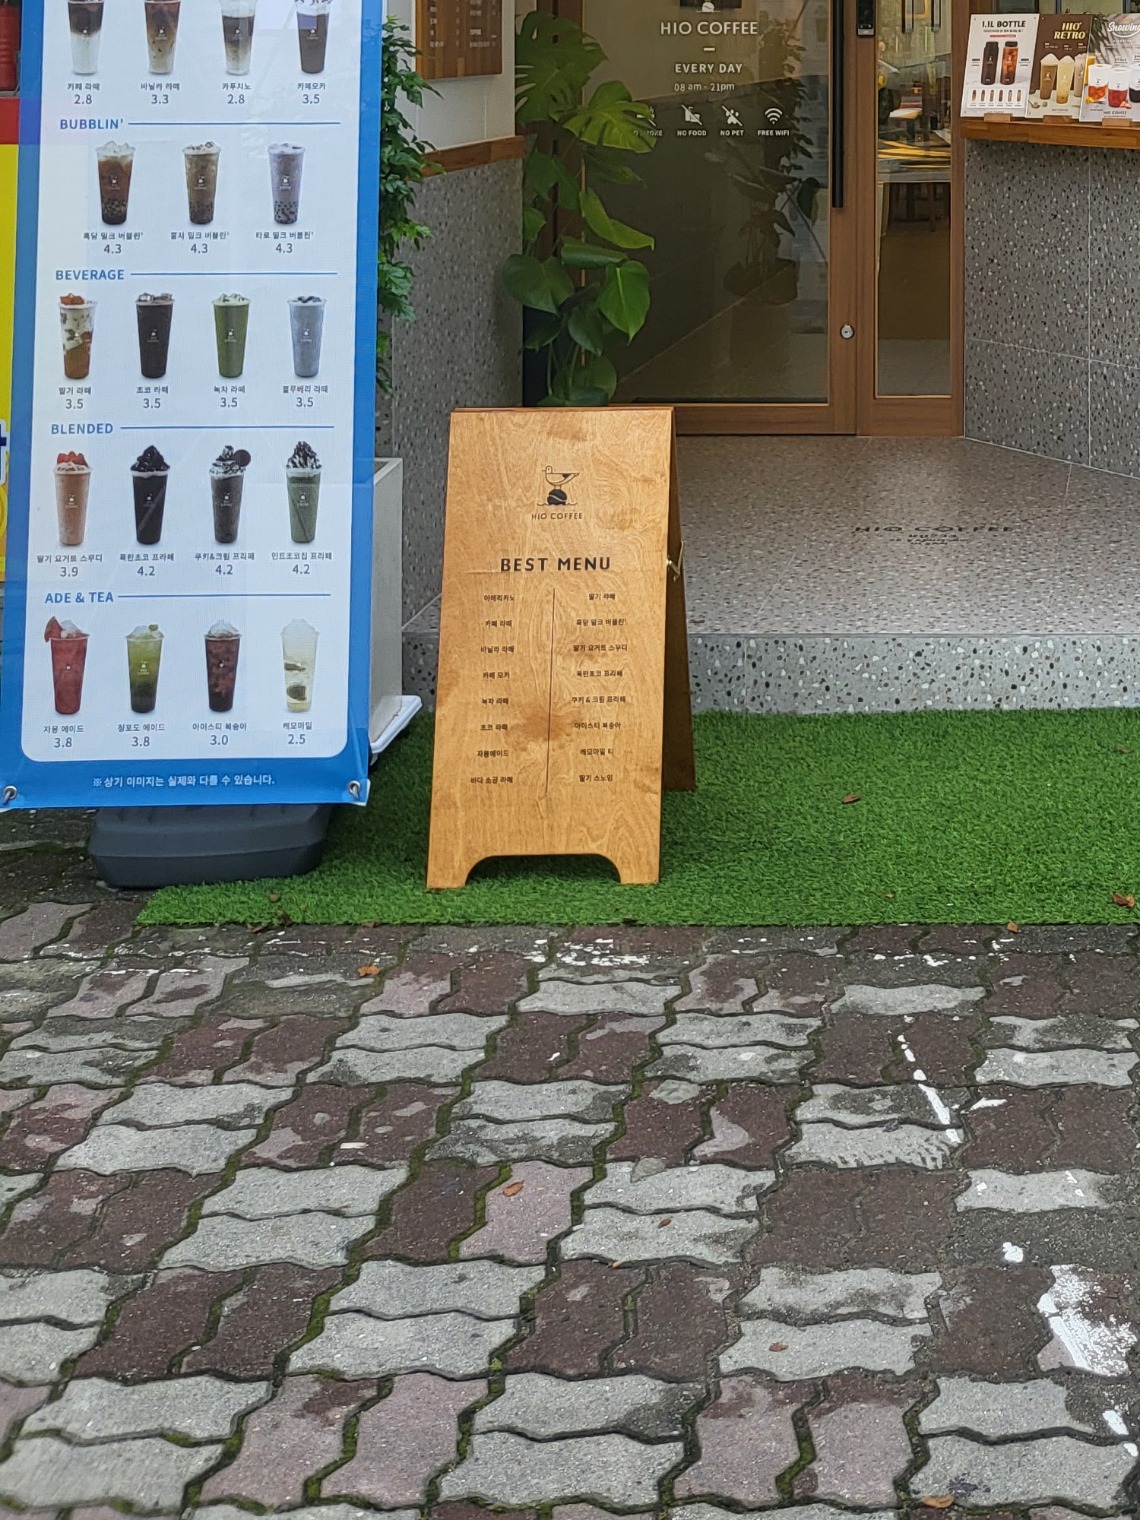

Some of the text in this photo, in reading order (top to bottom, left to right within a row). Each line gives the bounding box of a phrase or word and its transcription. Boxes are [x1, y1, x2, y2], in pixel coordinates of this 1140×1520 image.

[661, 21, 758, 35] HIO COFFEE
[997, 20, 1026, 28] BOTTLE
[1054, 31, 1086, 39] RETRO
[675, 64, 743, 73] EVERY DAY
[74, 94, 92, 104] 2.8
[151, 94, 169, 104] 3.3
[227, 94, 245, 104] 2.8
[302, 94, 320, 104] 3.5
[104, 244, 122, 254] 4.3
[191, 244, 208, 254] 4.3
[276, 243, 293, 254] 4.3
[56, 270, 125, 280] BEVERAGE
[65, 399, 84, 409] 3.5
[143, 398, 161, 408] 3.5
[220, 397, 238, 408] 3.5
[296, 397, 314, 408] 3.5
[52, 423, 113, 434] BLENDED
[551, 512, 583, 520] COFFEE
[215, 564, 233, 575] 4.2
[292, 564, 310, 574] 4.2
[500, 557, 611, 572] BEST MENU
[60, 566, 78, 577] 3.9
[137, 566, 155, 576] 4.2
[45, 592, 114, 604] ADE & TEA
[54, 737, 72, 748] 3.8
[132, 736, 150, 747] 3.8
[210, 735, 228, 745] 3.0
[288, 734, 305, 744] 2.5
[222, 775, 230, 786] 수
